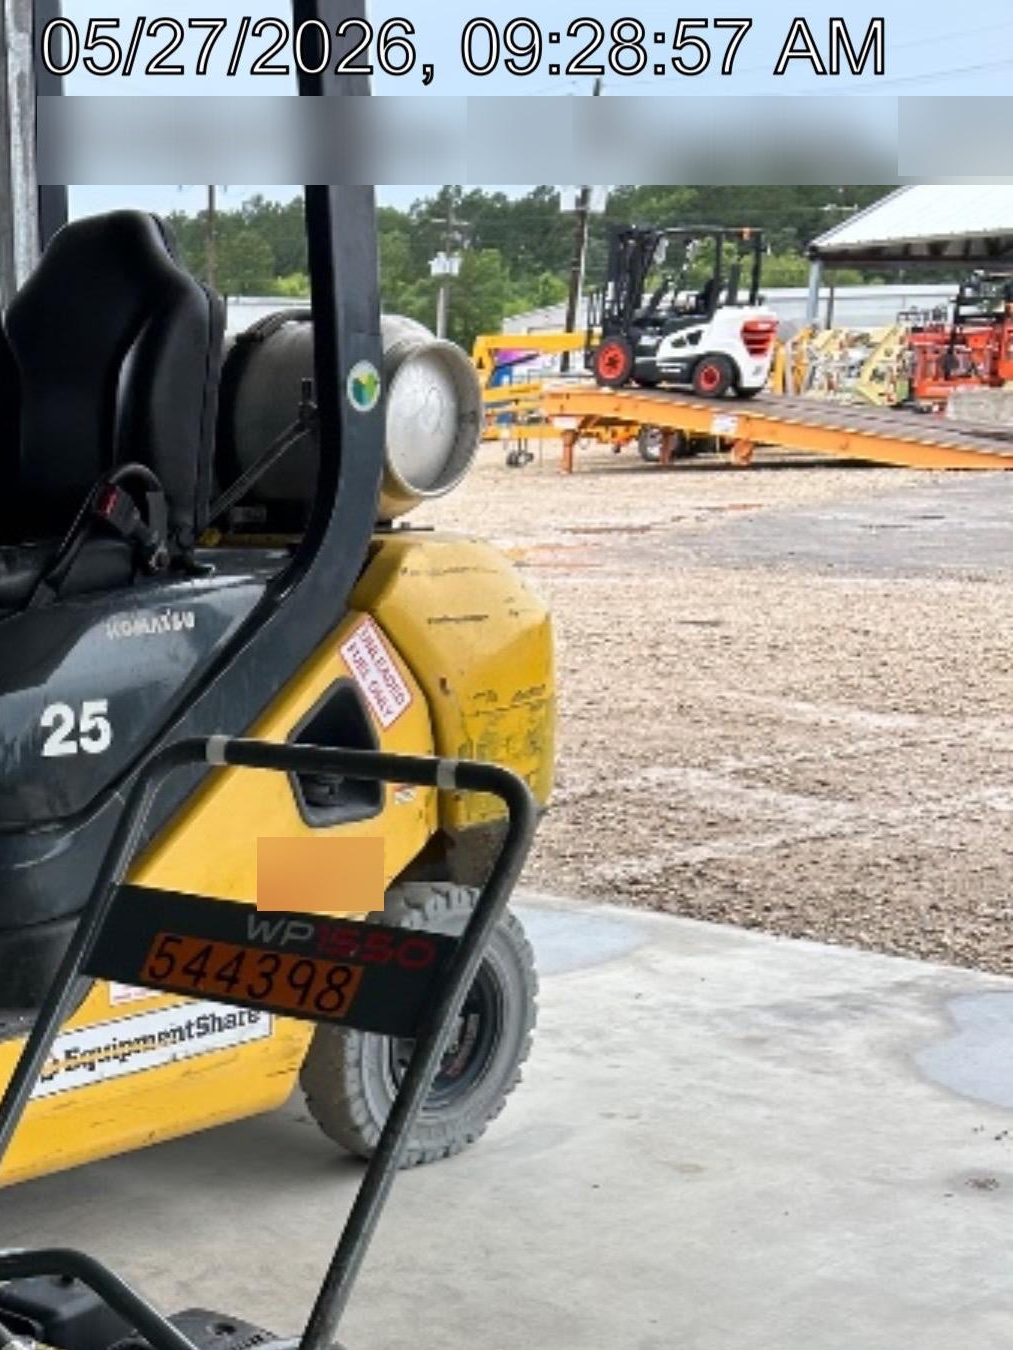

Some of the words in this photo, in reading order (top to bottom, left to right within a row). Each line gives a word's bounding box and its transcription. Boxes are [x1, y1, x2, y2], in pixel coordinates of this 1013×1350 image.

[106, 608, 196, 640] KOMATSU
[346, 642, 371, 682] FUEL
[367, 681, 393, 718] ONLY
[360, 628, 406, 706] UNLEADED
[40, 699, 112, 757] 25
[246, 914, 435, 968] WP1550
[147, 934, 358, 1015] 544398
[65, 1010, 261, 1071] EquipmentShare
